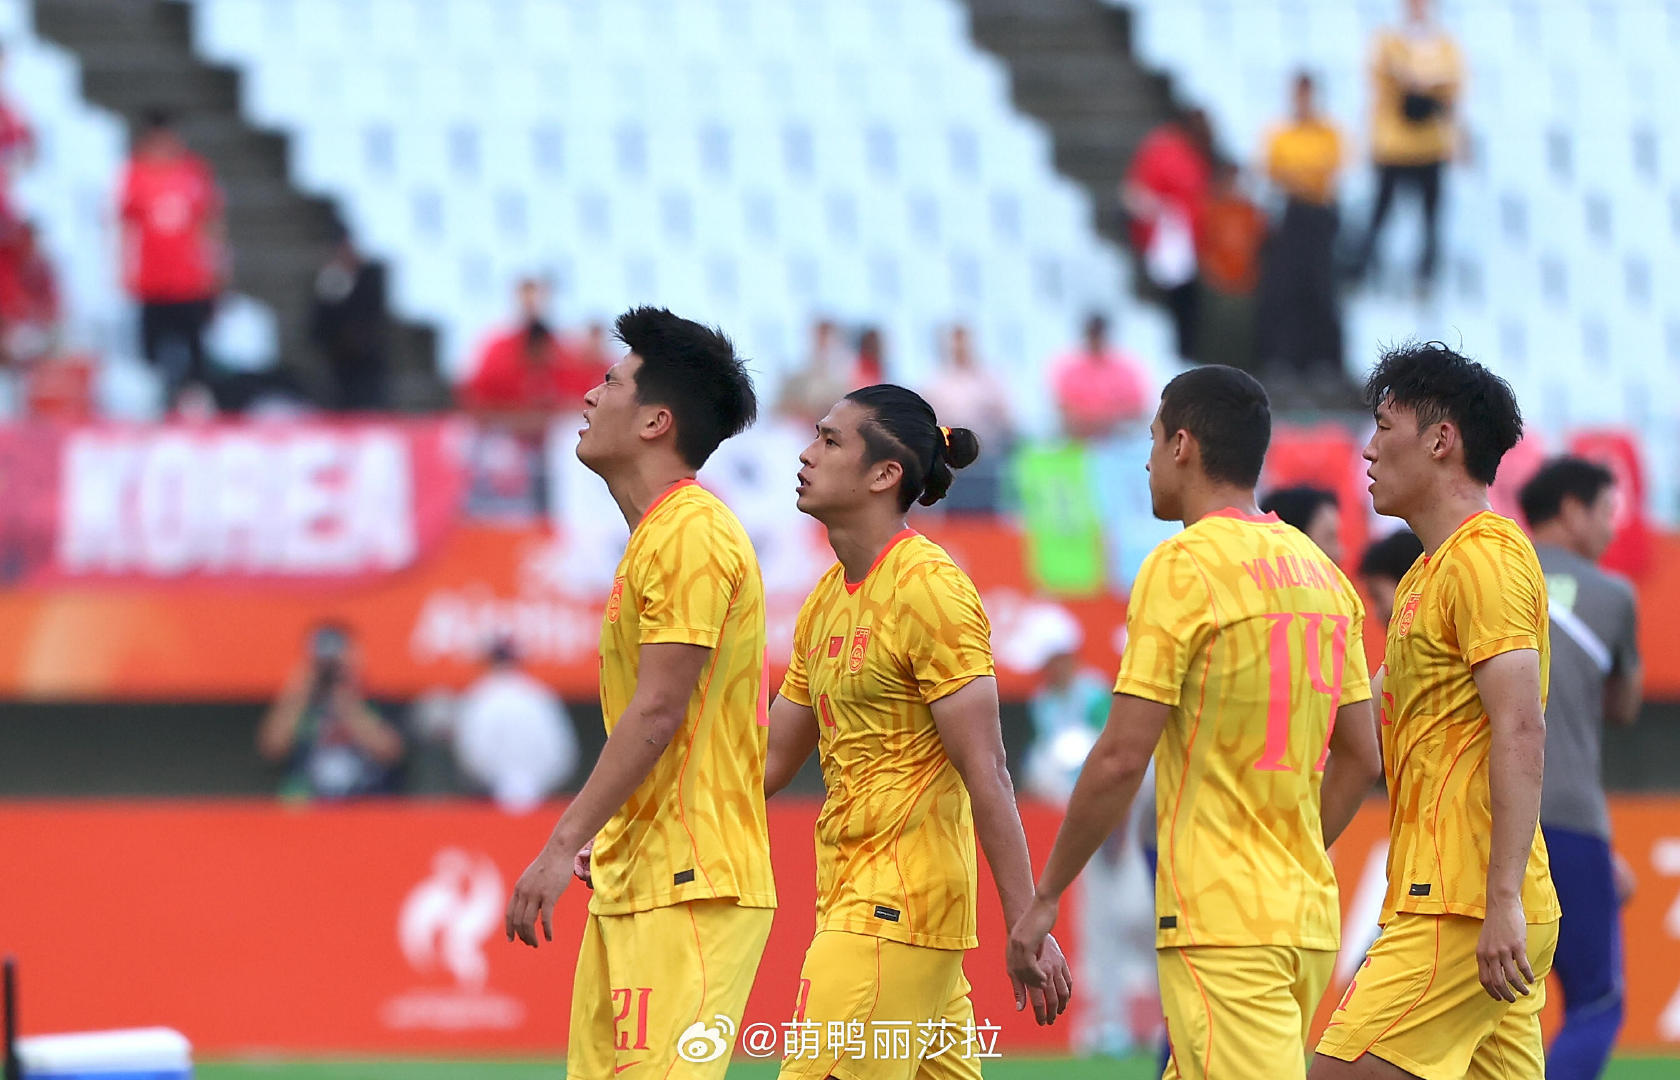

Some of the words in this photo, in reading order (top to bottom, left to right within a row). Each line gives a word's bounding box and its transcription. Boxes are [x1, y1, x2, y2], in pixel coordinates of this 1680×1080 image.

[62, 433, 413, 575] KOREA
[1254, 612, 1349, 772] 14
[611, 987, 653, 1051] 21
